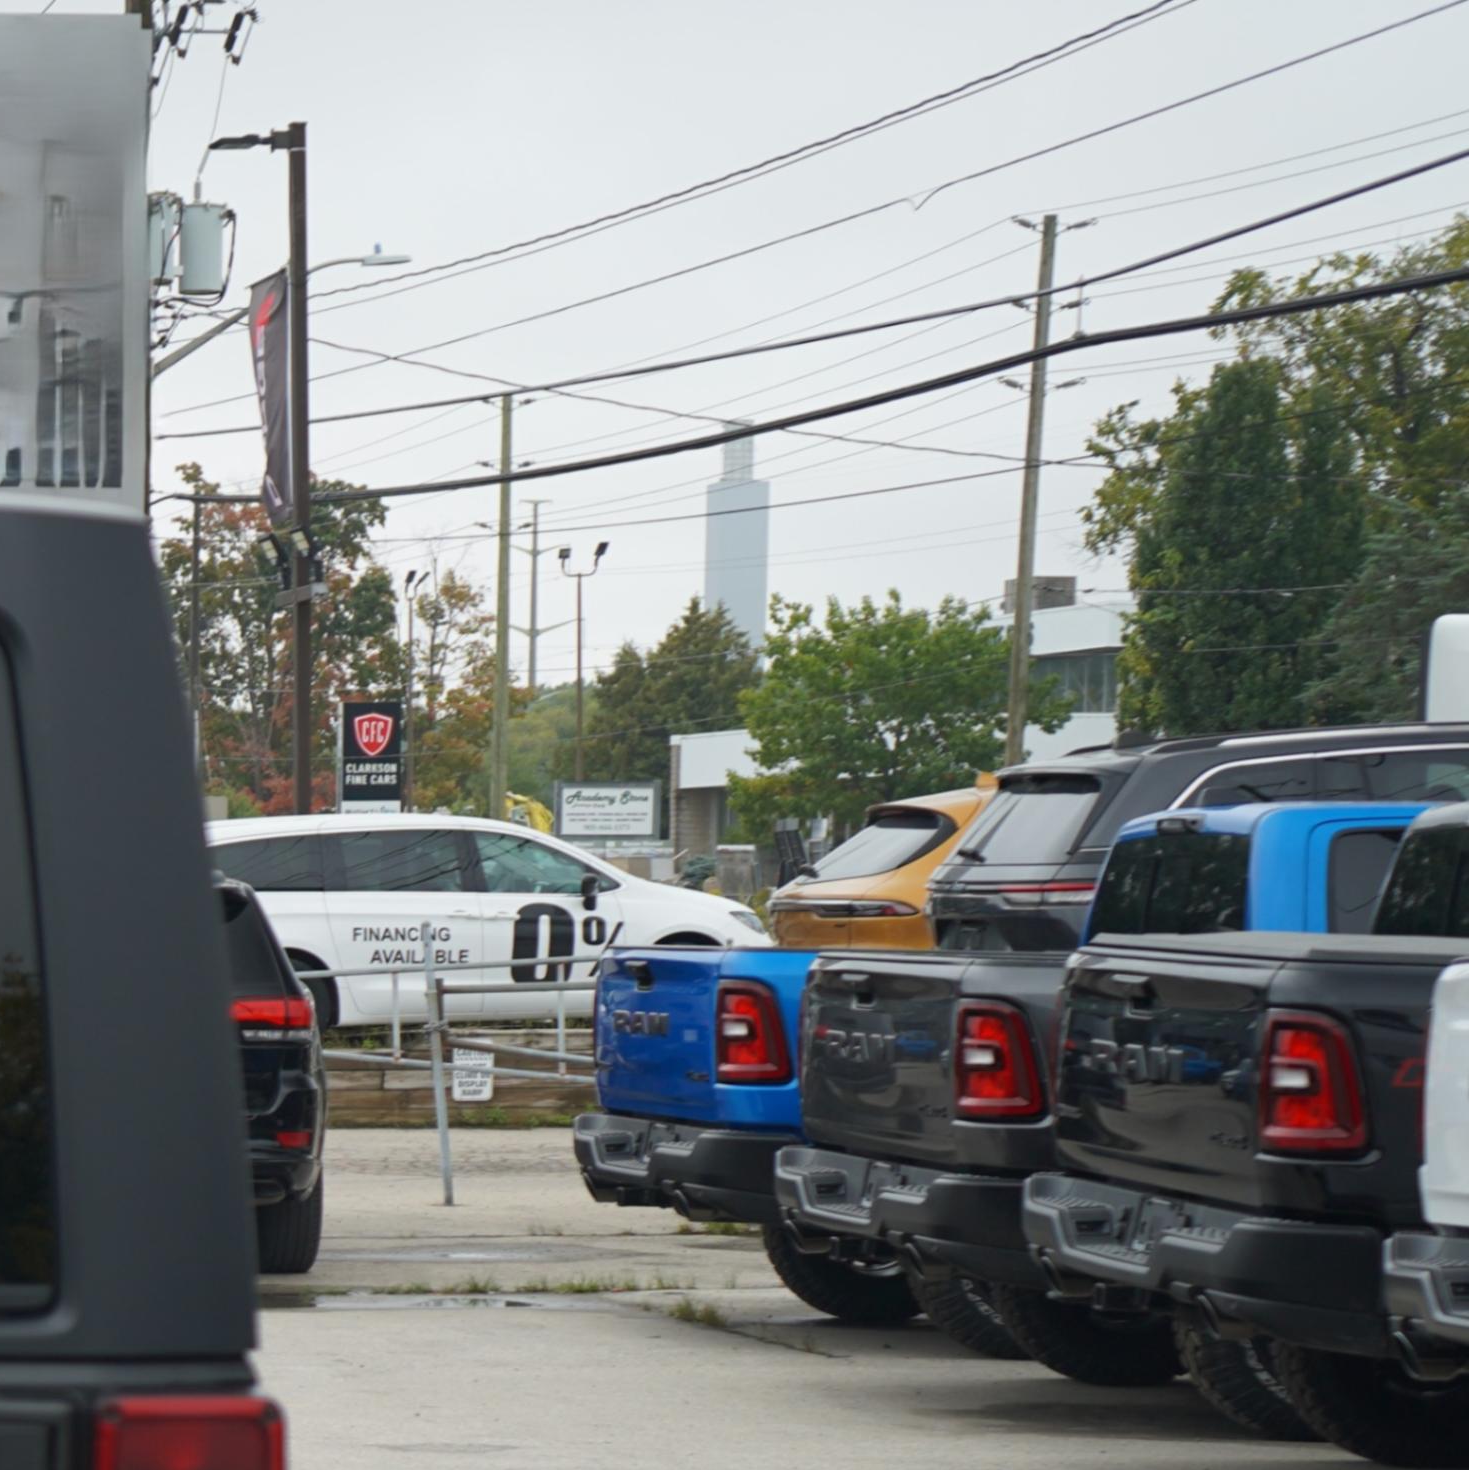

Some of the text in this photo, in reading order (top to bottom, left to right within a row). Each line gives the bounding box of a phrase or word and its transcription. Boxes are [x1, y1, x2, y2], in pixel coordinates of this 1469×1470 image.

[361, 720, 387, 743] CFC
[345, 763, 398, 774] CLARKSON
[345, 774, 398, 785] FINE CARS
[369, 949, 470, 965] AVAILBLE
[613, 1010, 670, 1036] RAM
